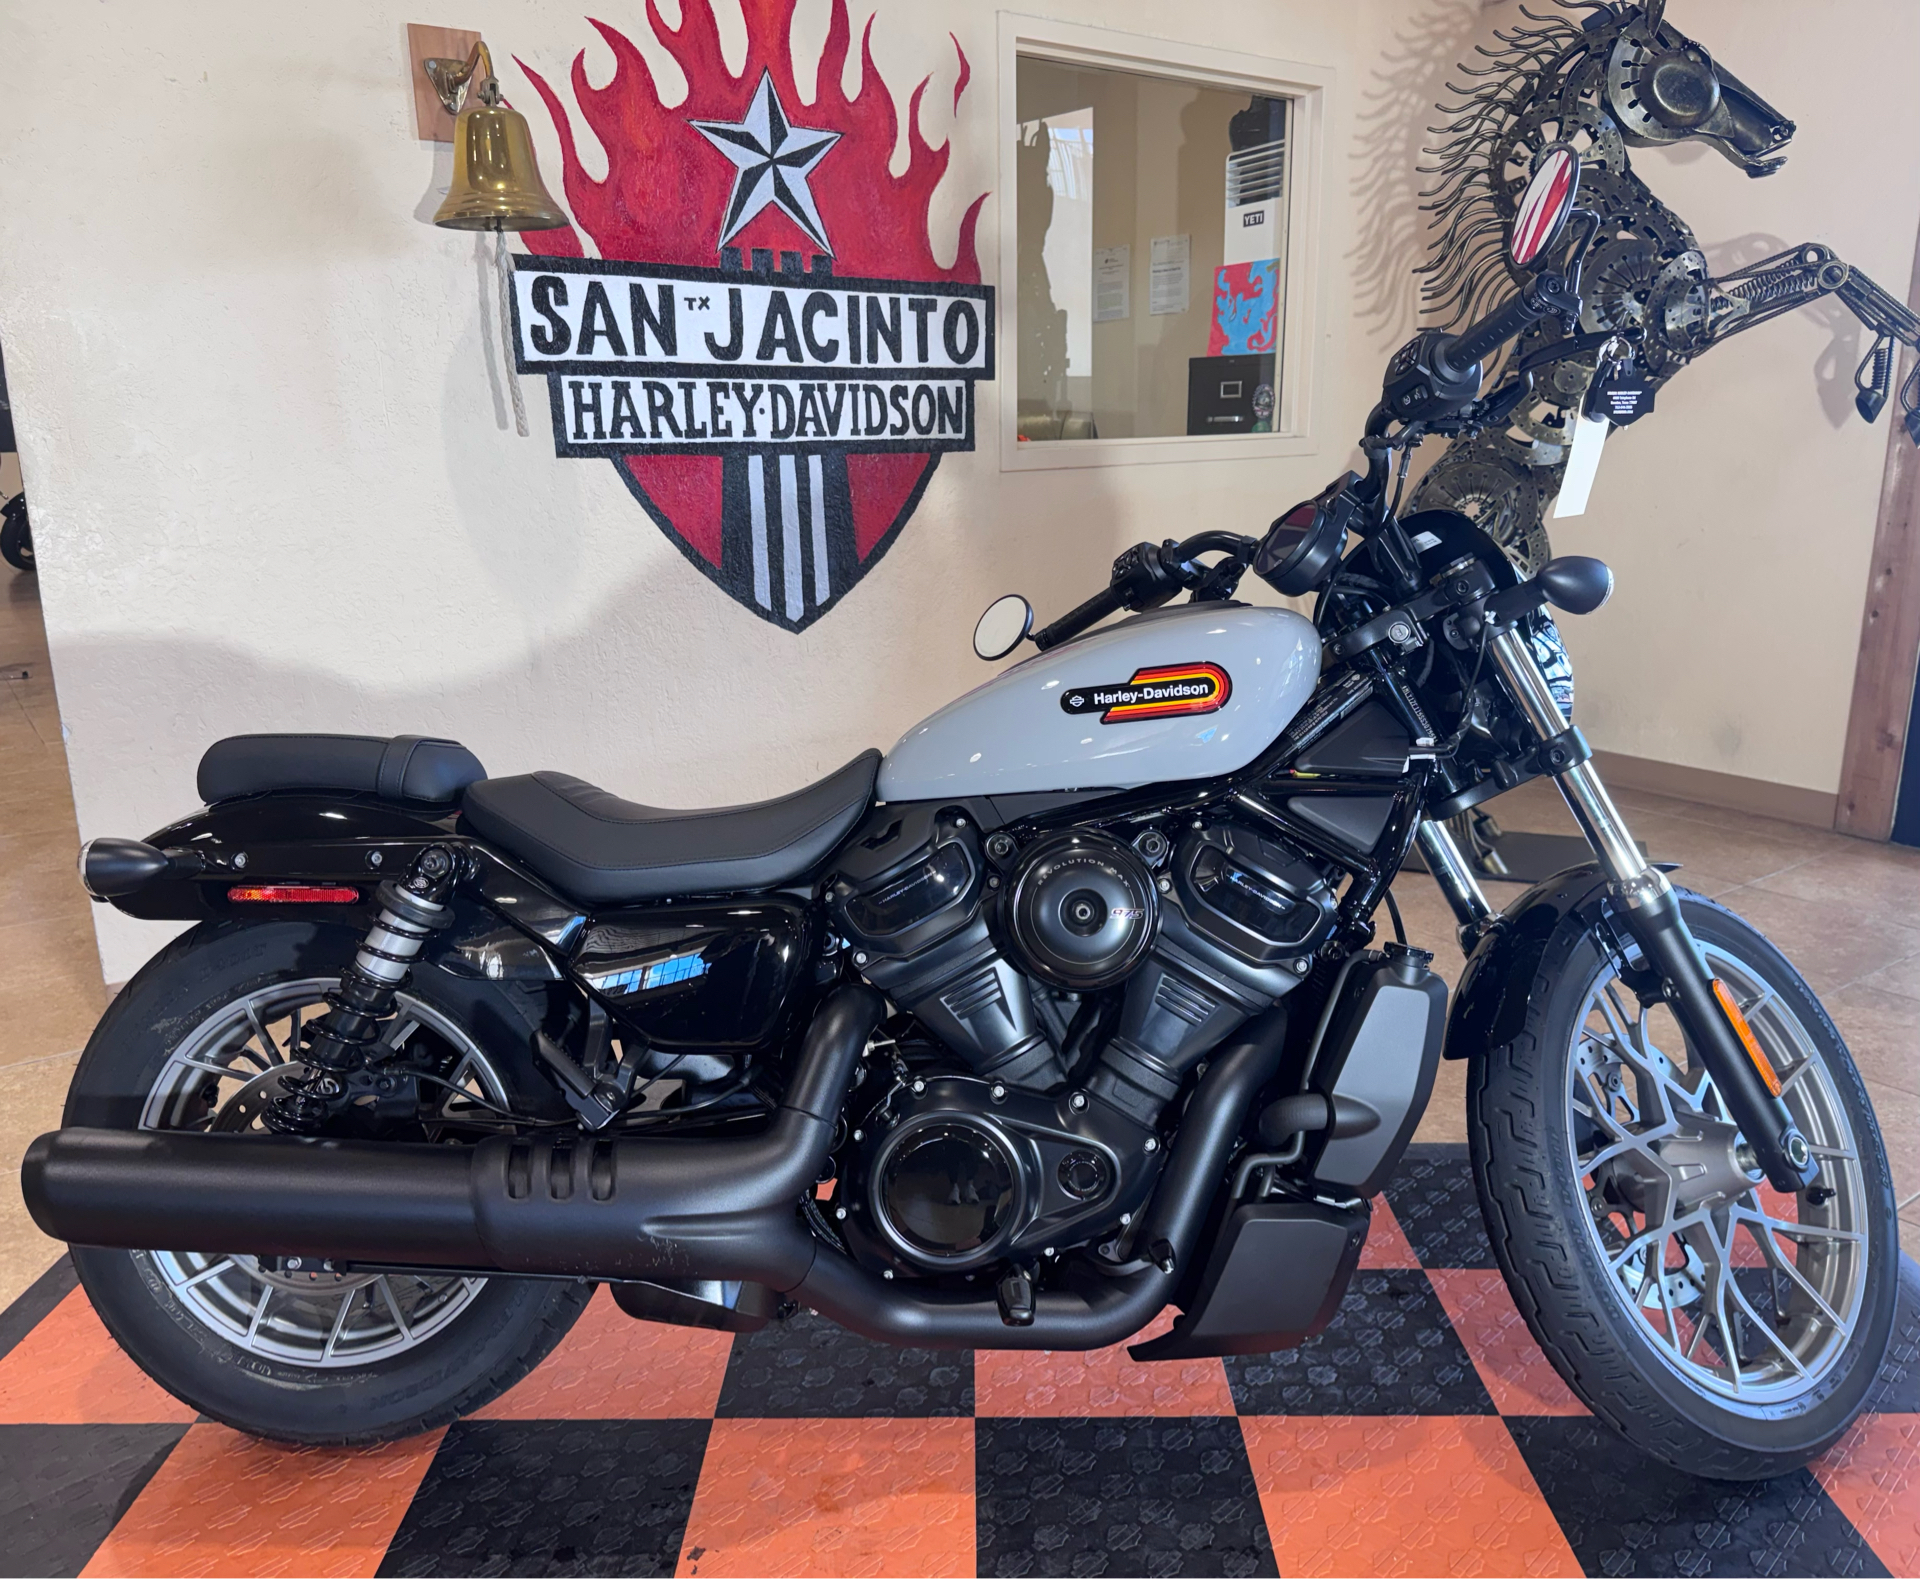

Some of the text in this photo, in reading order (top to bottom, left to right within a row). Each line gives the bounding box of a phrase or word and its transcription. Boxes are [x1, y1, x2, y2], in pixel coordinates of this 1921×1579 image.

[1243, 212, 1264, 226] YETI
[684, 295, 711, 312] TX
[530, 275, 980, 365] SAN JACINTO
[1093, 683, 1209, 706] Harley-Davidson
[1037, 858, 1131, 888] REVOLUTION MAX
[1109, 907, 1145, 920] 975
